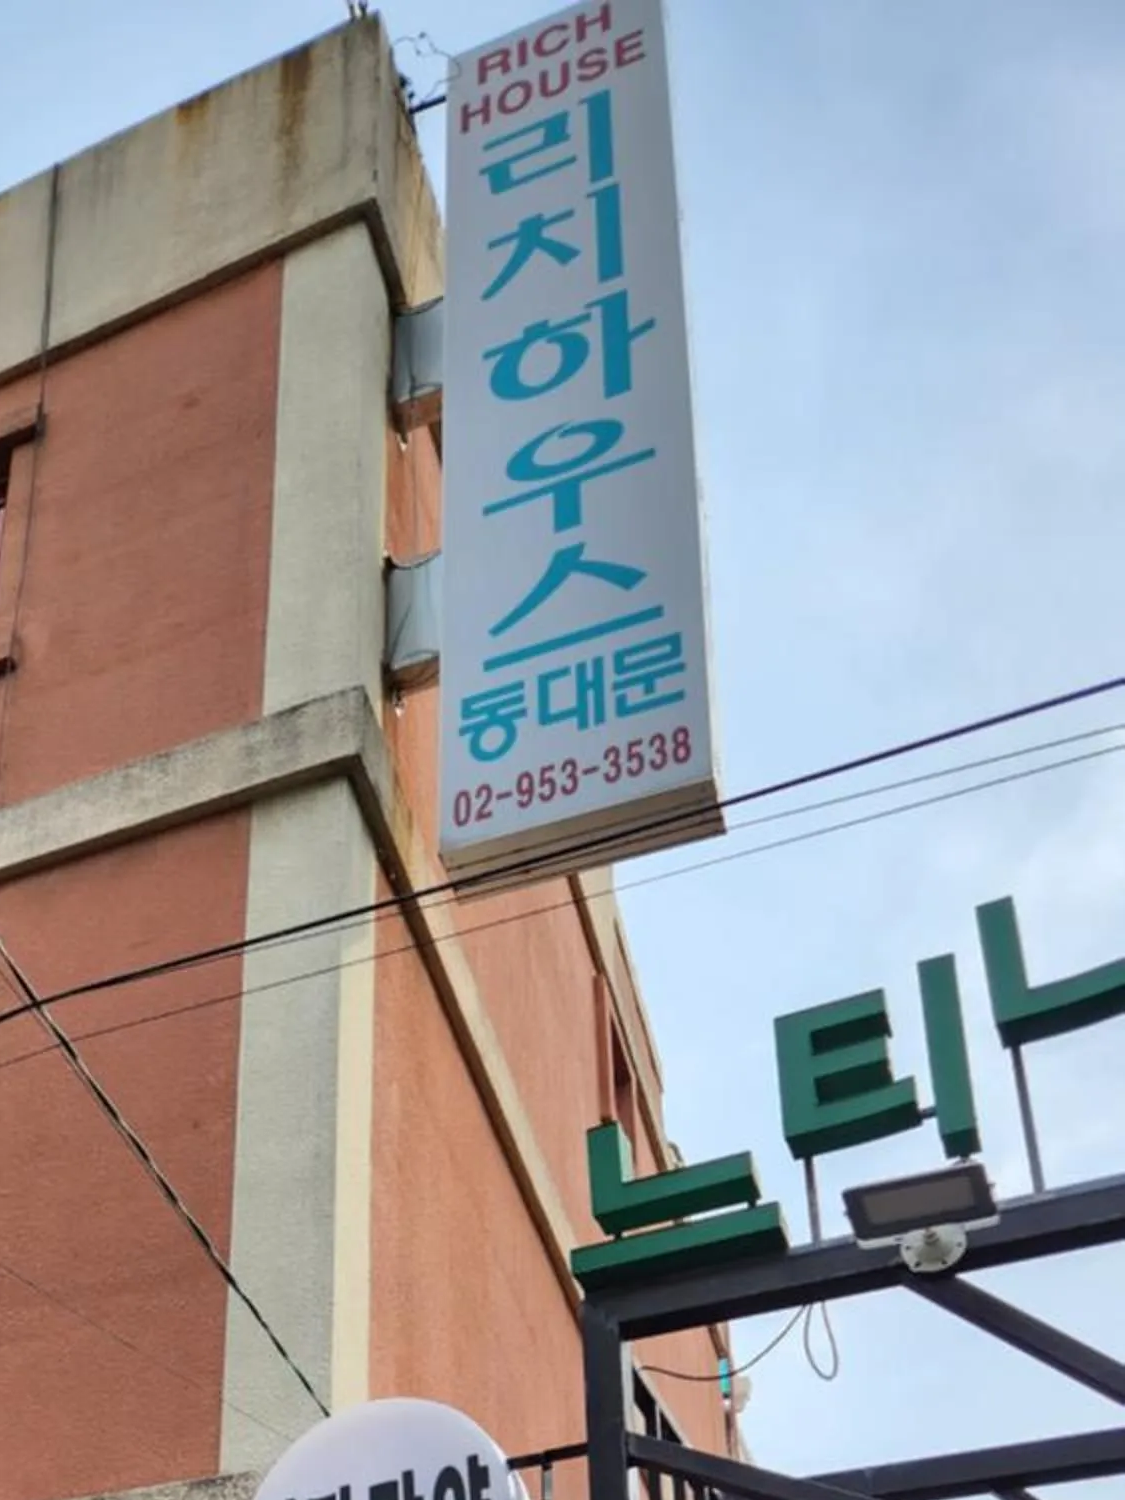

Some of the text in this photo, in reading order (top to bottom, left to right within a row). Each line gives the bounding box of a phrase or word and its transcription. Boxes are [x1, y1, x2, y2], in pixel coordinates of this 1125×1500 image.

[460, 29, 647, 134] HOUSE
[476, 3, 612, 86] RICH
[478, 89, 665, 673] 리치하우스
[458, 631, 687, 763] 동대문
[452, 726, 693, 828] 02-953-3538
